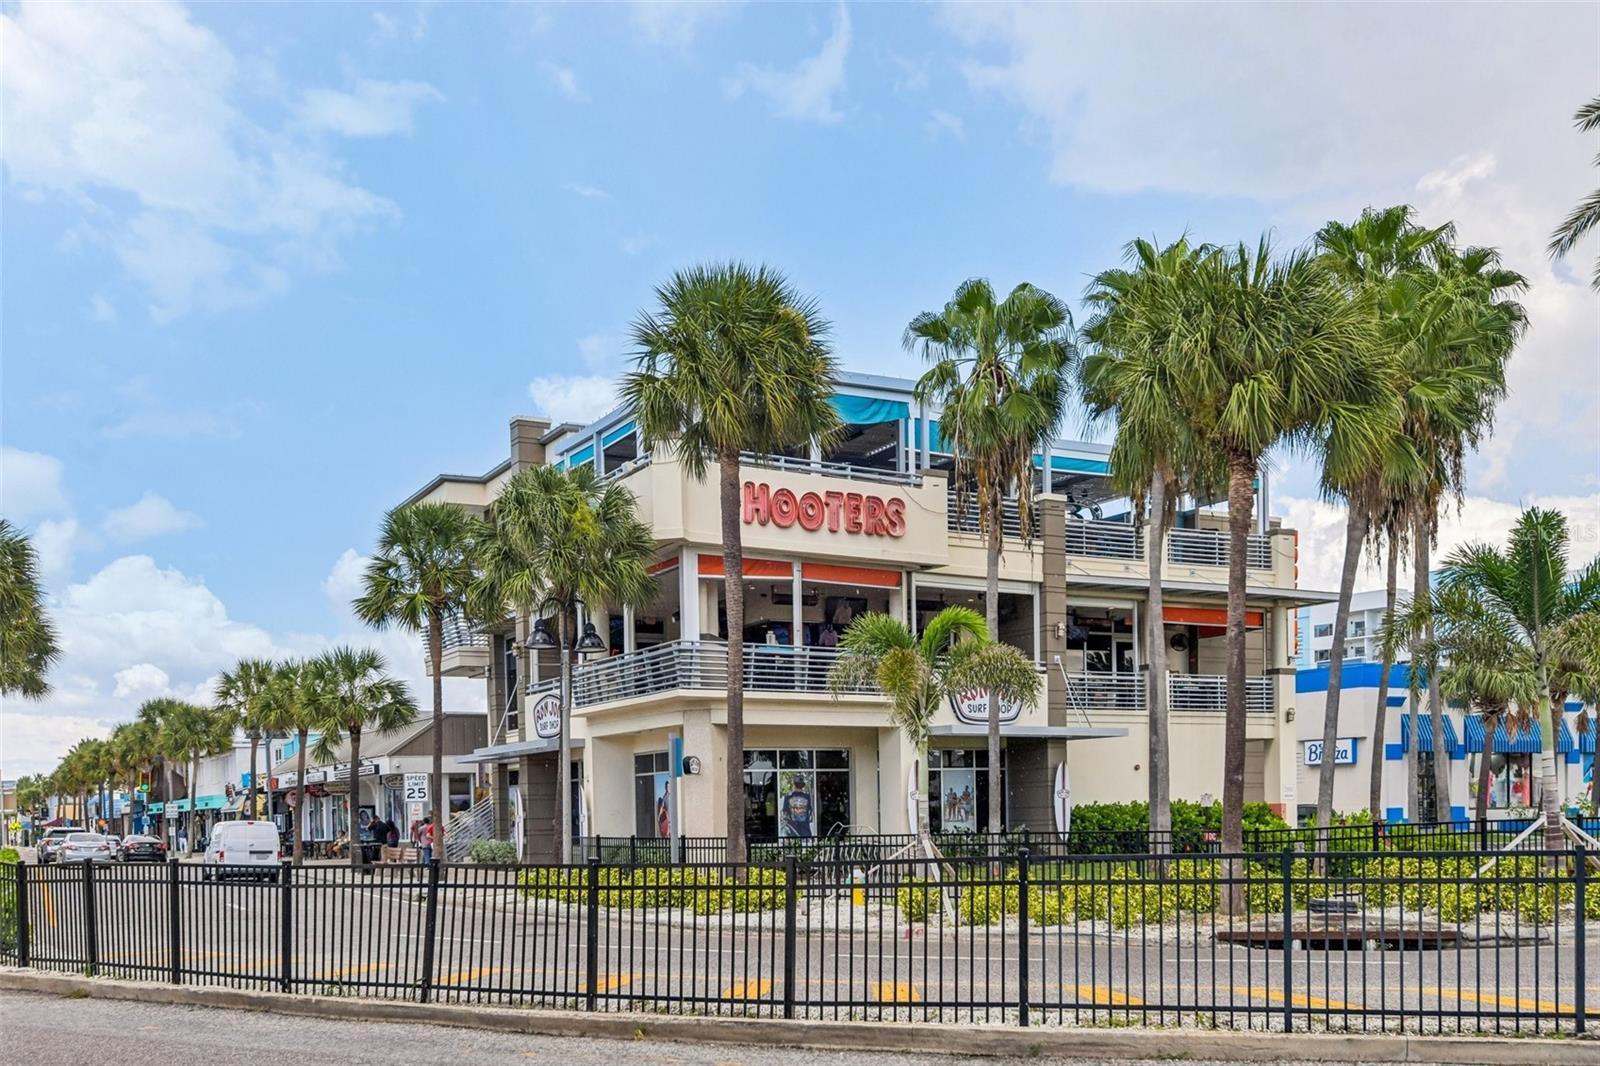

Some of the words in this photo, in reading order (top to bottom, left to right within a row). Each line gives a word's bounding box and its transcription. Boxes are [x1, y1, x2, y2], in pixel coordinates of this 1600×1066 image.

[743, 481, 907, 538] HOOTERS
[967, 703, 987, 714] SURF
[406, 787, 427, 799] 25
